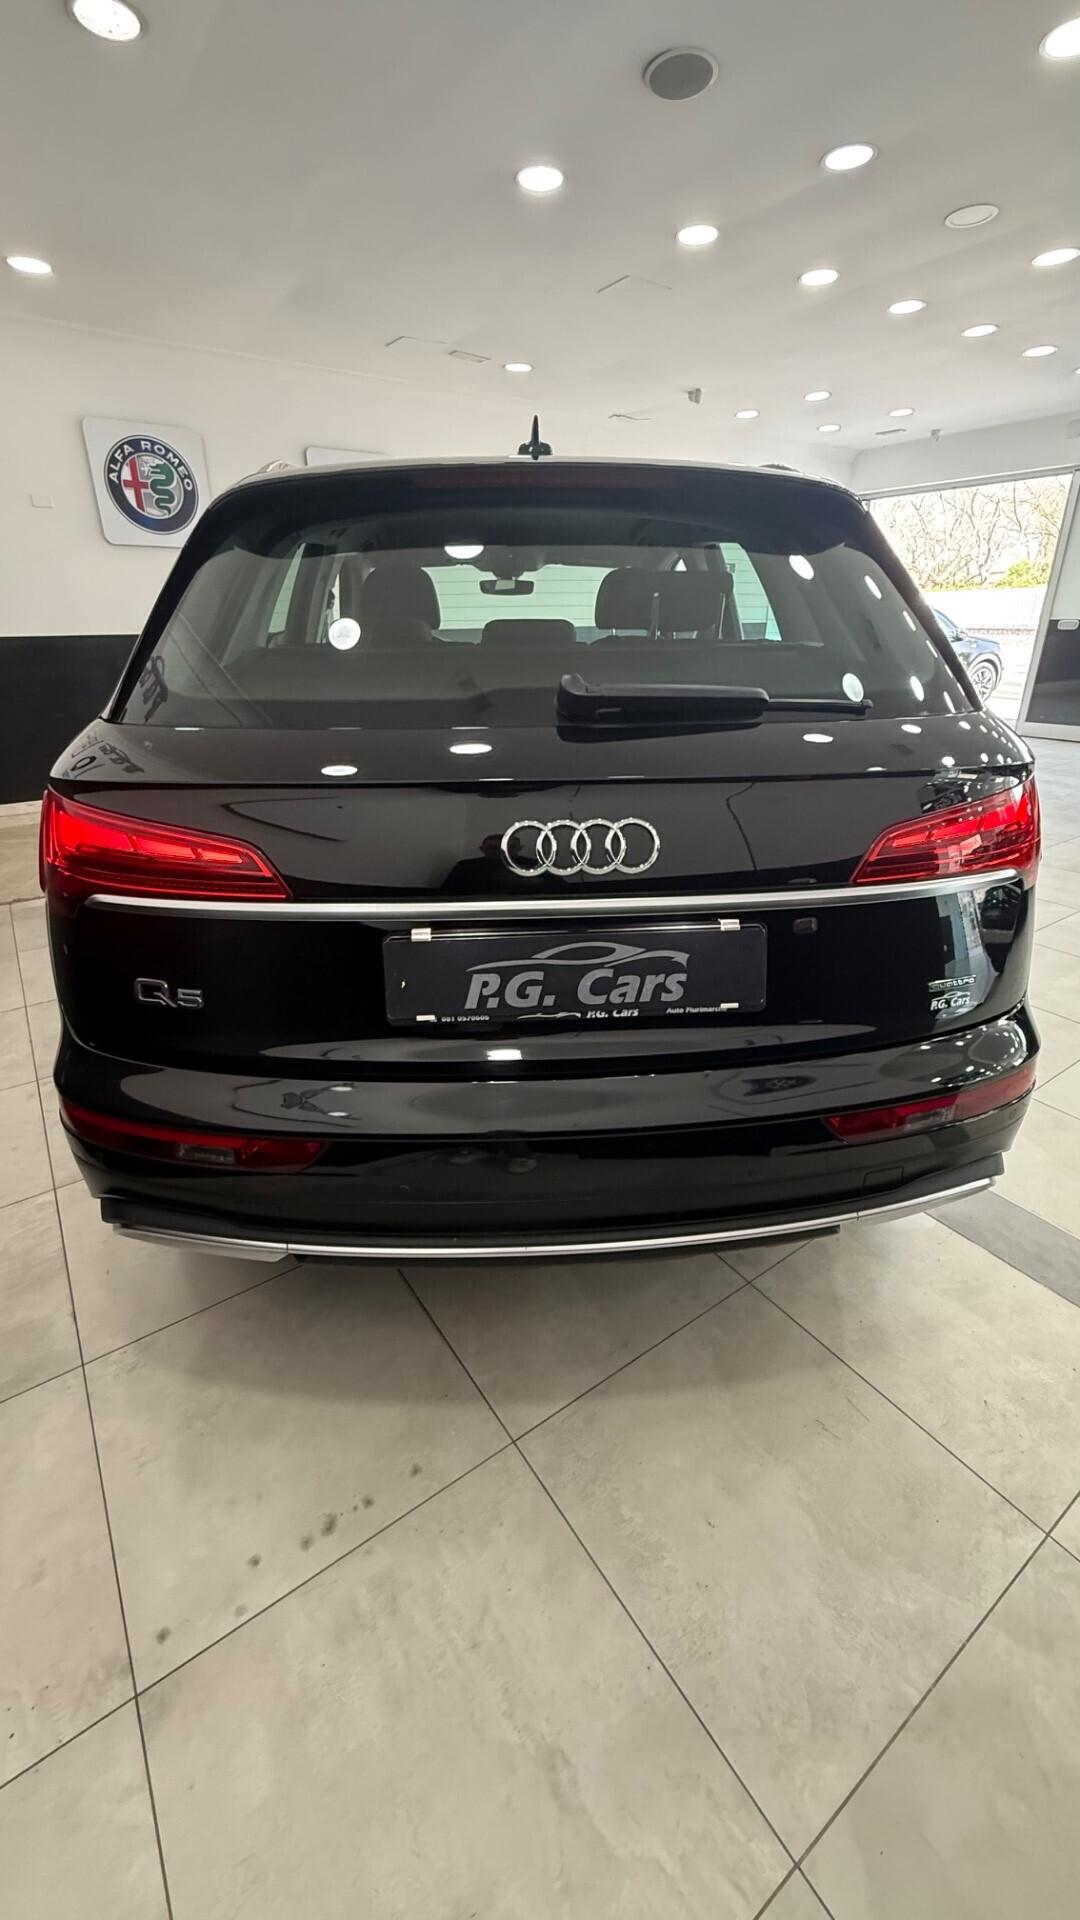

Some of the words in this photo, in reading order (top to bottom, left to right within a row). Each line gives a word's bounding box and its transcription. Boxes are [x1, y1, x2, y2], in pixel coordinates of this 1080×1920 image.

[109, 444, 134, 483] ALFA
[140, 440, 193, 490] ROMEO
[134, 977, 204, 1008] Q5
[464, 971, 555, 1009] P.G.
[577, 968, 688, 1005] Cars
[930, 999, 949, 1011] P.G.
[951, 997, 970, 1007] Cars
